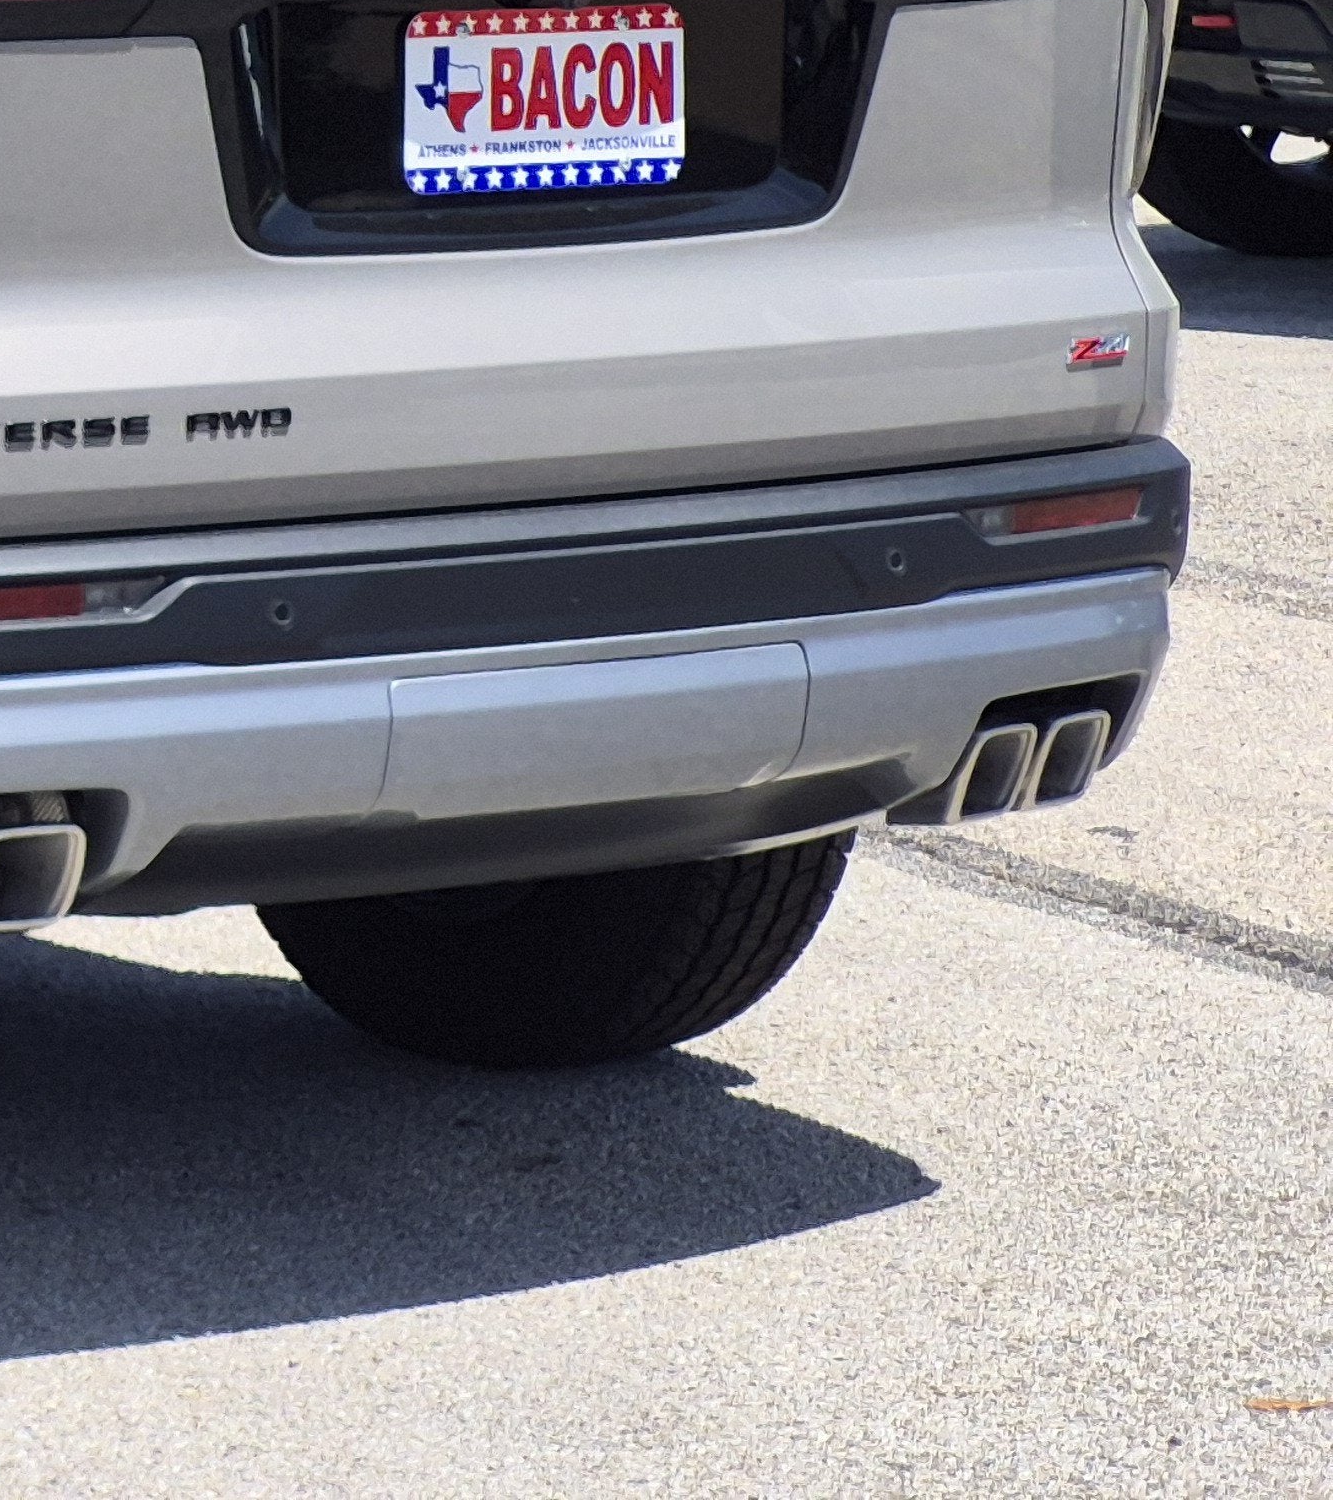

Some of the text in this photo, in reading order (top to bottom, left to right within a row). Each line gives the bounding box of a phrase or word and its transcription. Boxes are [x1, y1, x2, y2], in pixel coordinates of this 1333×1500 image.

[490, 41, 675, 132] BACON
[418, 135, 676, 158] ATHENS FRANKSTON JACKSONVILLE
[186, 407, 292, 443] AWD
